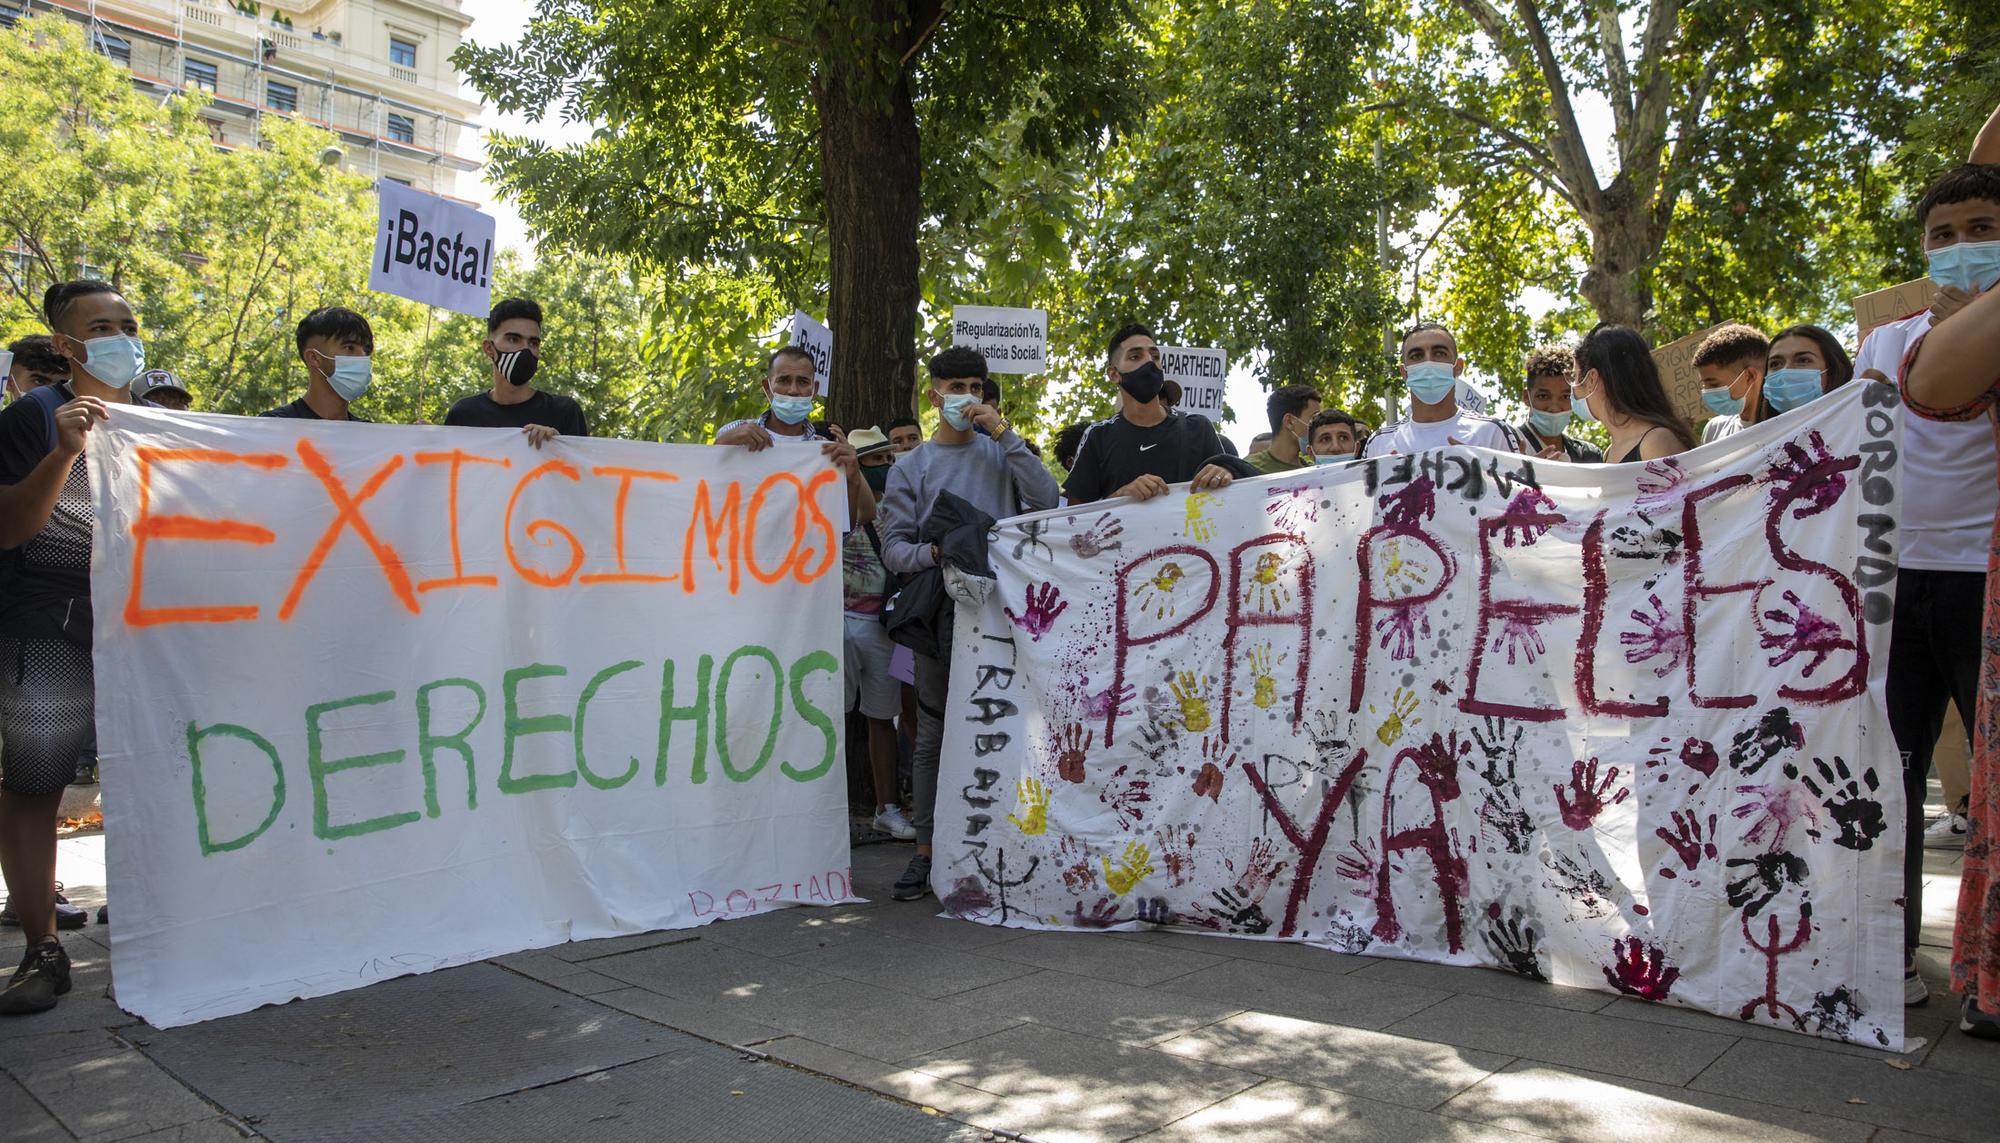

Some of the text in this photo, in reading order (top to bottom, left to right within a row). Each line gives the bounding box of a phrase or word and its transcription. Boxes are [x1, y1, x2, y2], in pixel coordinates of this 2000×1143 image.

[383, 208, 492, 288] ¡Basta!
[956, 320, 1042, 340] #RegularizaciónYa,
[1011, 345, 1042, 360] Social.
[1161, 353, 1223, 382] APARTHEID,
[1184, 386, 1197, 408] TU
[1199, 388, 1223, 410] LEY!
[124, 438, 839, 628] EXIGIMOS
[1105, 454, 1869, 750] PAPELES
[186, 645, 839, 857] DERECHOS
[953, 624, 1019, 866] TRABAJAR
[1241, 746, 1468, 957] YA
